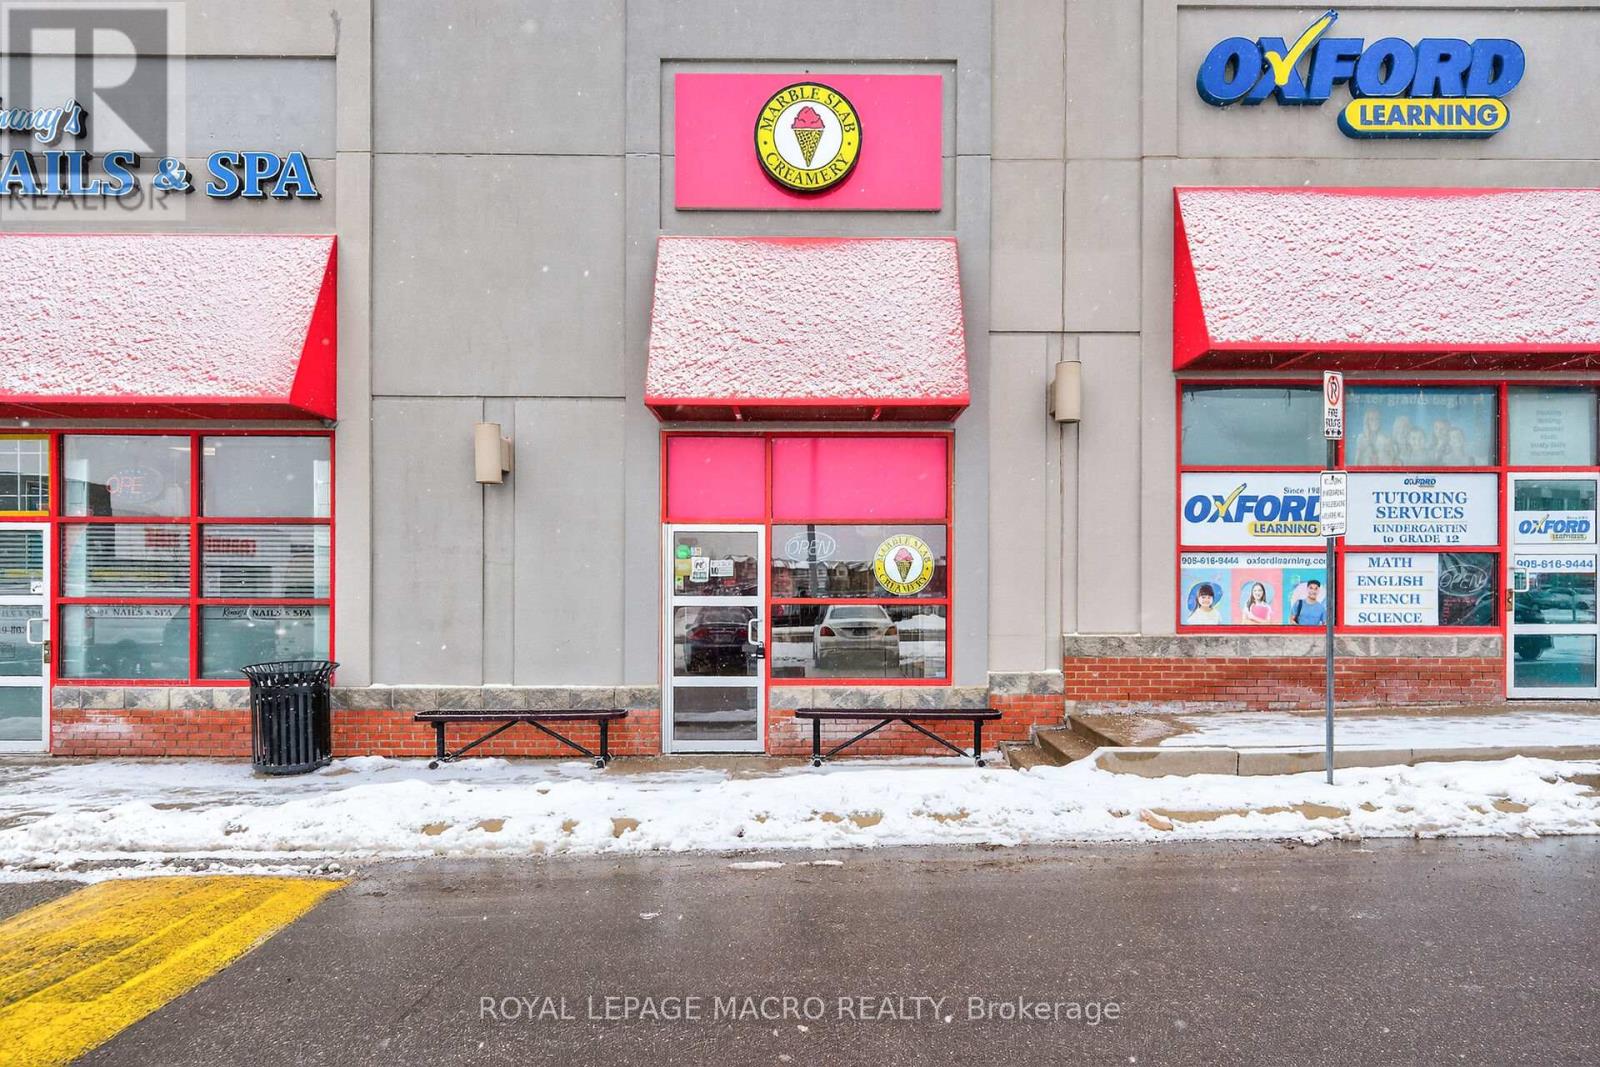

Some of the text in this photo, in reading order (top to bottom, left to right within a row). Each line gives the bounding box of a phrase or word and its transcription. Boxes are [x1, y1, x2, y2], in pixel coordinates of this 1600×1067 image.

[1196, 10, 1526, 106] OXFORD
[760, 86, 856, 133] MARBLE SLAB
[1358, 103, 1500, 128] LEARNING
[0, 150, 319, 199] AILS & SPA
[765, 152, 849, 186] CREAMERY
[1283, 487, 1304, 495] Since
[1372, 491, 1468, 504] TUTORING
[1375, 506, 1464, 519] SERVICES
[1254, 523, 1318, 534] LEARNING
[1373, 524, 1468, 533] KINDERGARTEN
[1518, 516, 1591, 534] OXFORD
[1383, 535, 1460, 543] to GRADE 12
[788, 539, 832, 556] OPEN
[1368, 557, 1412, 568] MATH
[1357, 575, 1424, 587] ENGLISH
[1440, 566, 1485, 589] OPEN
[1360, 593, 1421, 605] FRENCH
[252, 608, 281, 617] NAILS
[293, 608, 312, 617] SPA
[1358, 612, 1423, 624] SCIENCE
